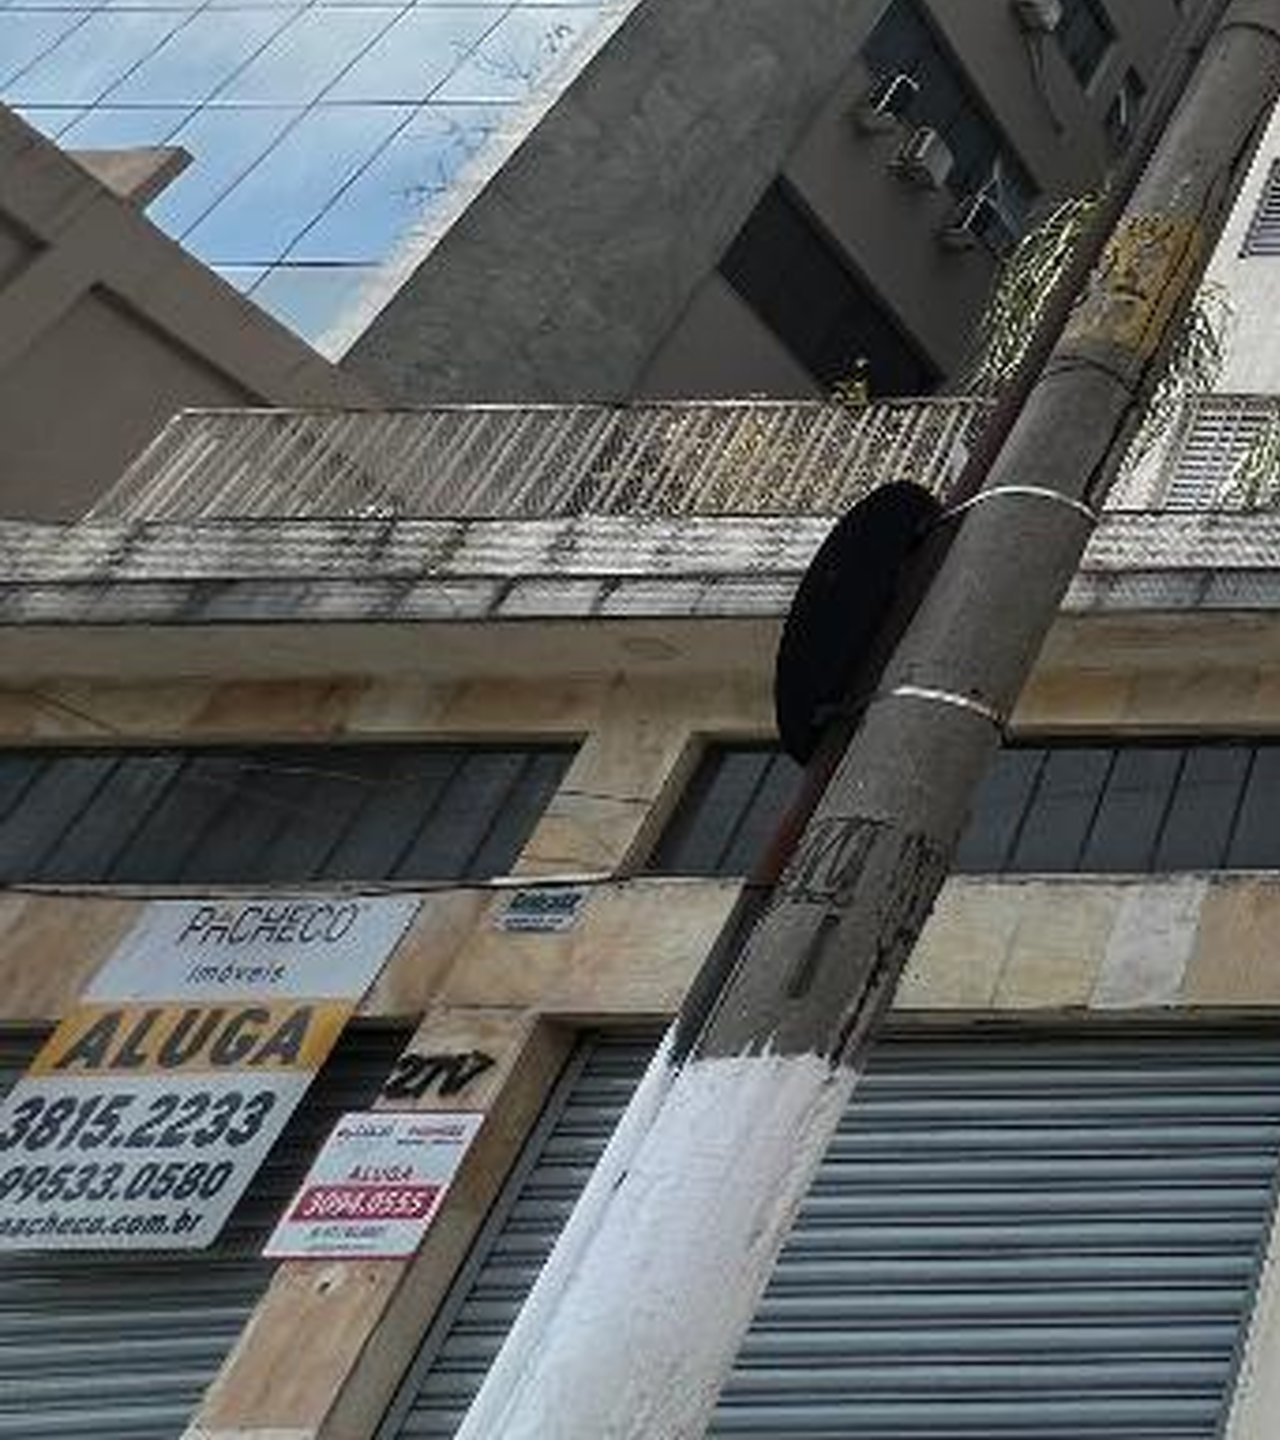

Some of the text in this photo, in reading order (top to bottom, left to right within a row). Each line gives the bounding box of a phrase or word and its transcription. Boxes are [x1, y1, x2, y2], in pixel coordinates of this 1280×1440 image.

[176, 904, 359, 945] PACHECO
[56, 1008, 315, 1069] ALUGA
[0, 1090, 276, 1151] 3815.2233
